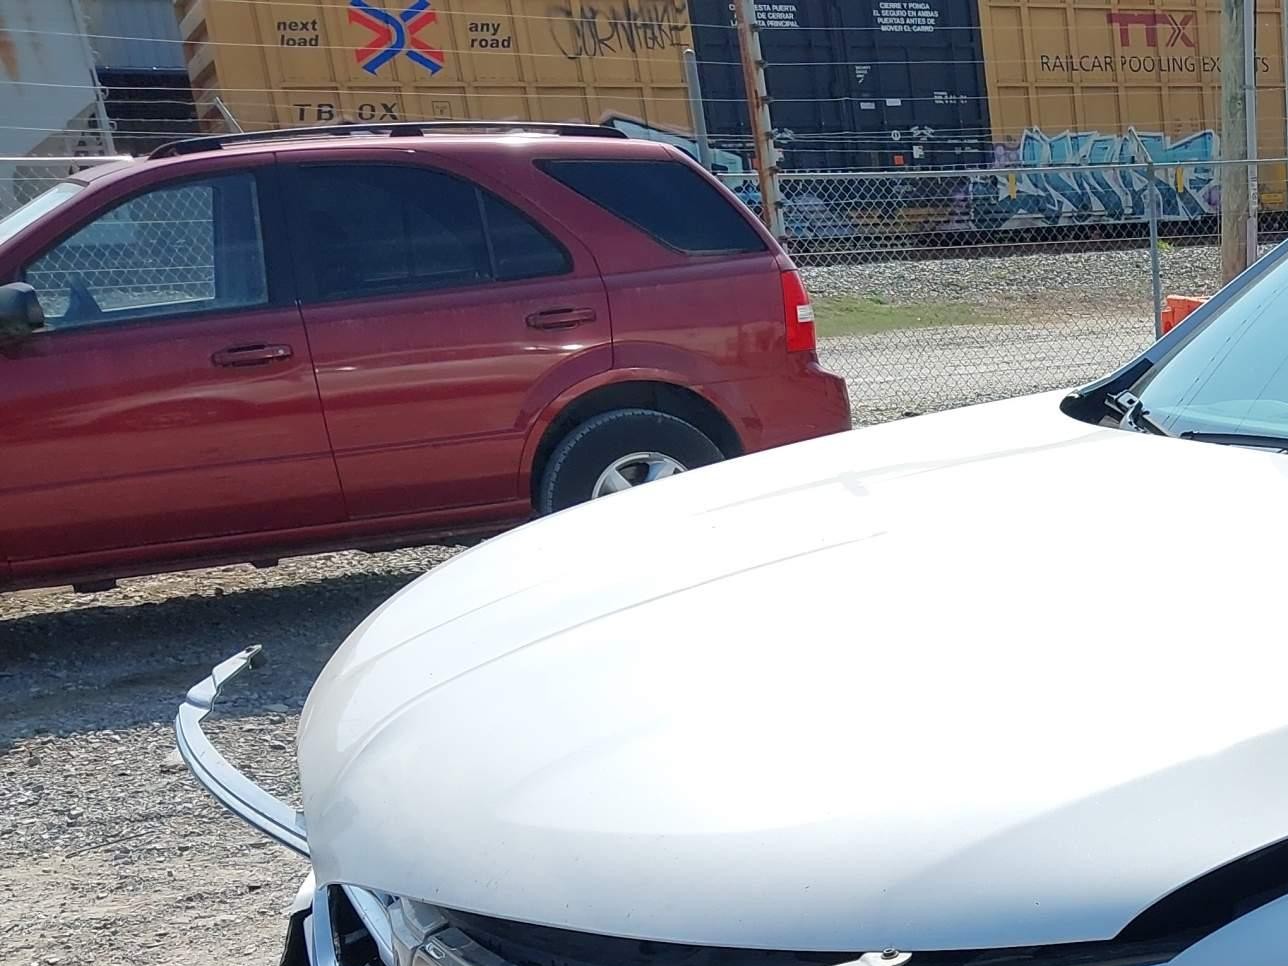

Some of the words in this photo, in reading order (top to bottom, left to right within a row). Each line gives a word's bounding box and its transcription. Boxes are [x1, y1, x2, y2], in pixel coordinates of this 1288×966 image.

[276, 18, 318, 32] next
[468, 21, 501, 36] any
[1106, 12, 1197, 48] TTX
[280, 34, 319, 47] load
[470, 36, 512, 49] road
[1040, 54, 1114, 72] RAILCAR
[1120, 55, 1195, 73] POOLING
